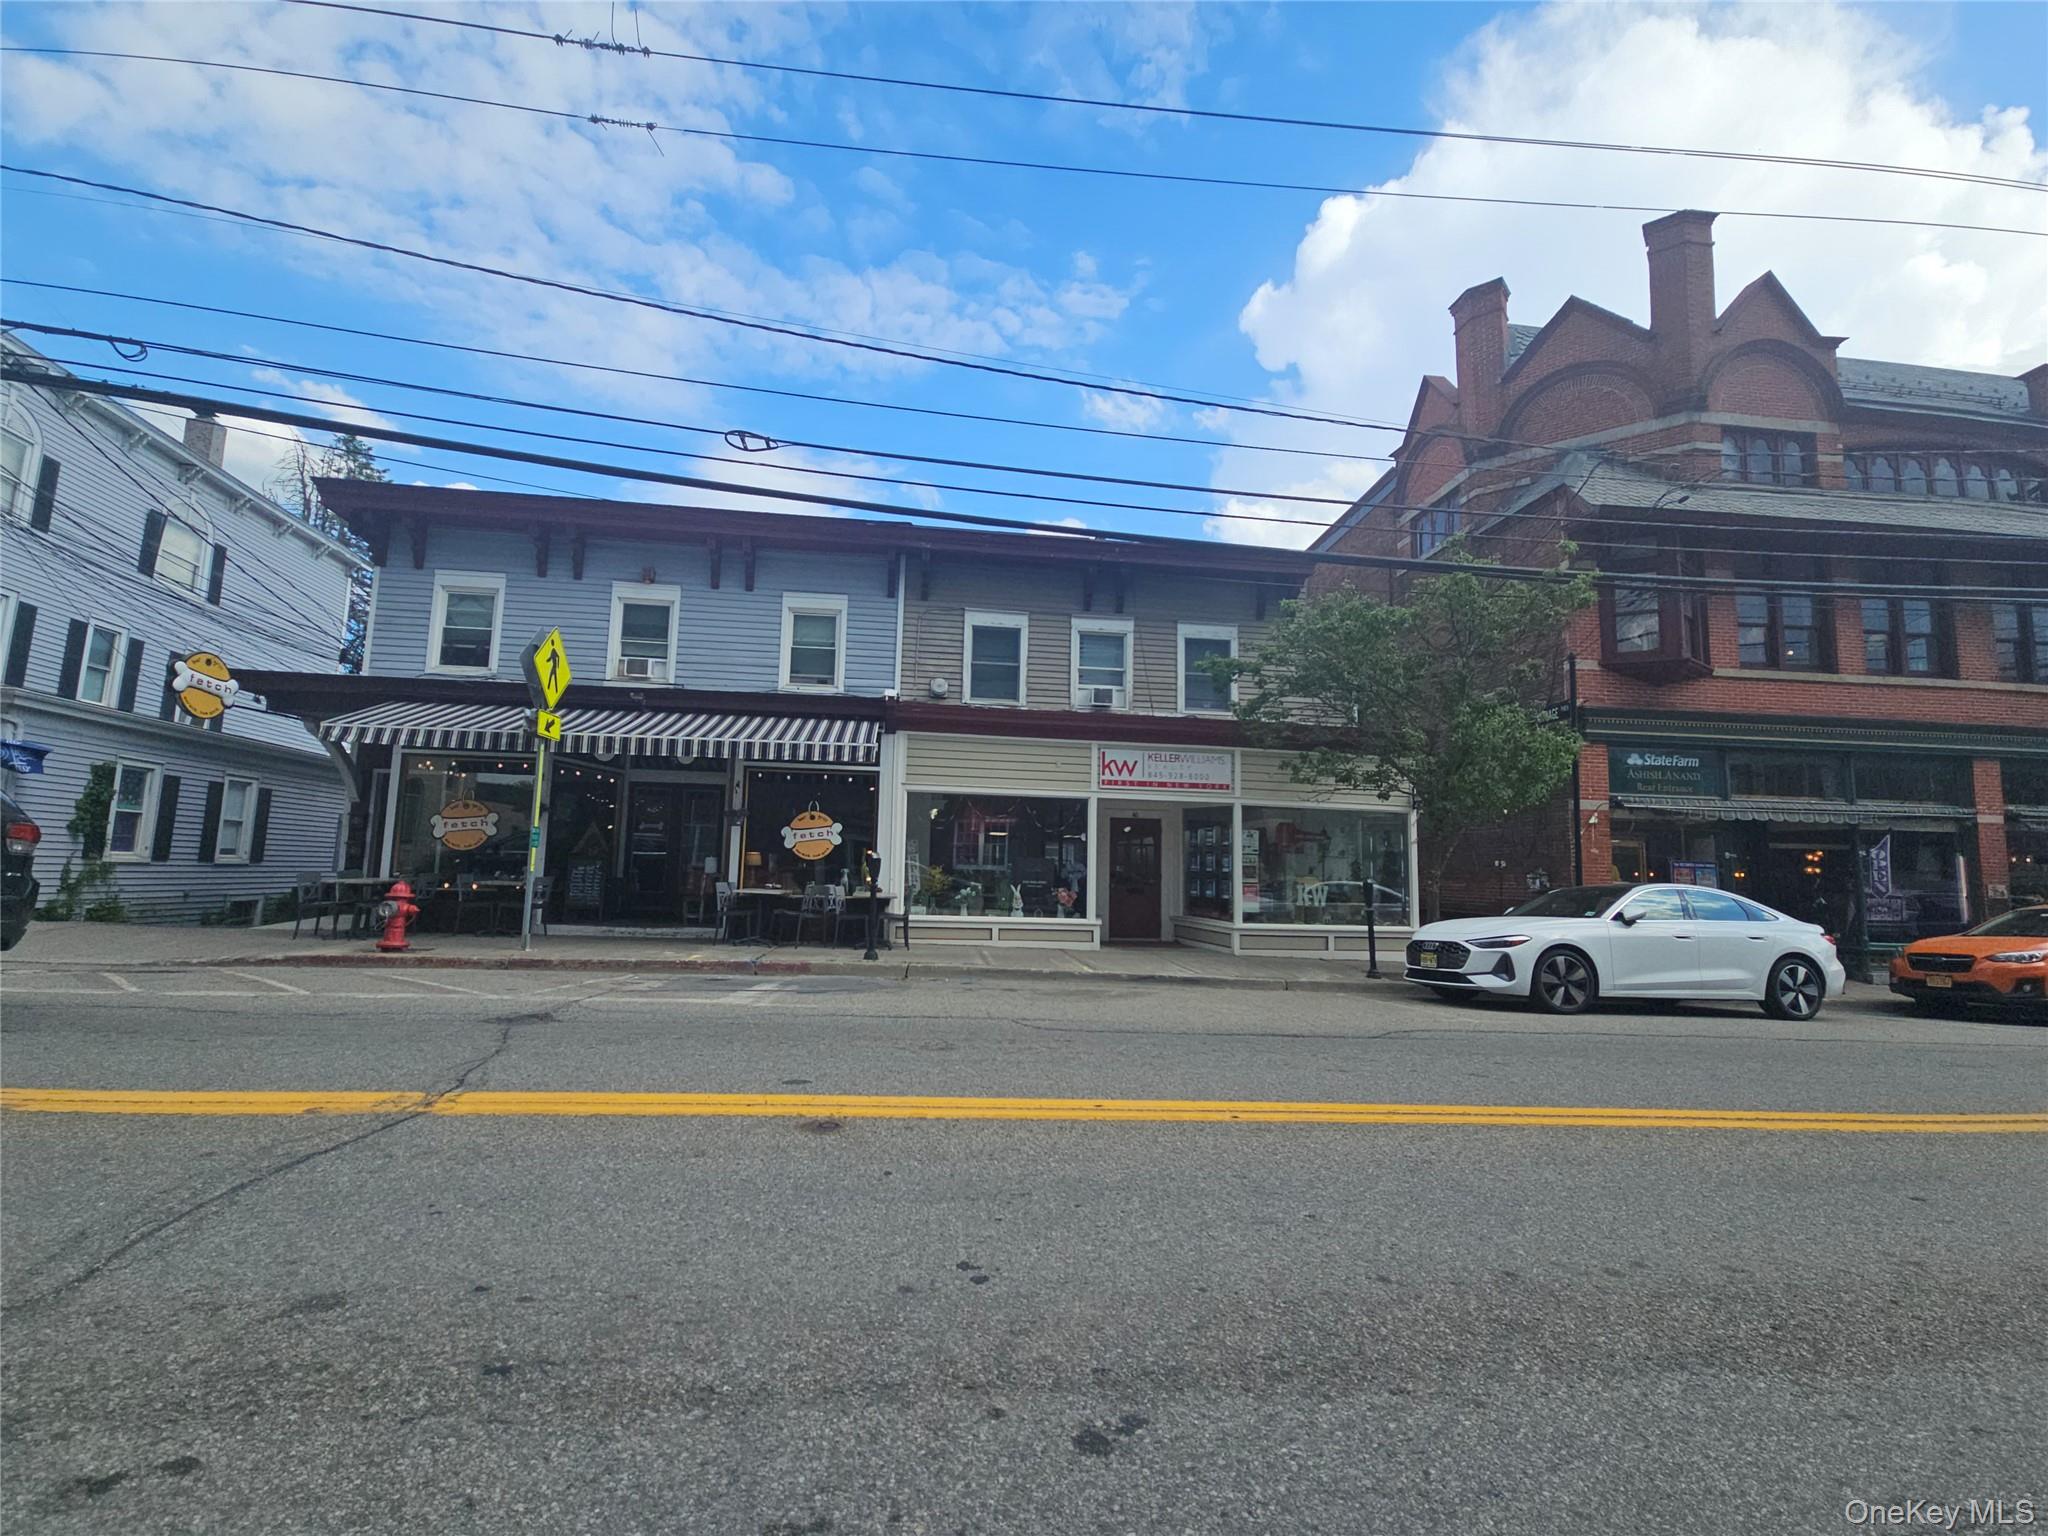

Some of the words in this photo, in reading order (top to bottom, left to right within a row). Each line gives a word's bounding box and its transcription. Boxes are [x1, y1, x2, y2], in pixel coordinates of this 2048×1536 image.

[190, 673, 232, 694] fetch
[1101, 751, 1138, 777] kw
[443, 818, 489, 829] fetch
[793, 829, 834, 840] fetch
